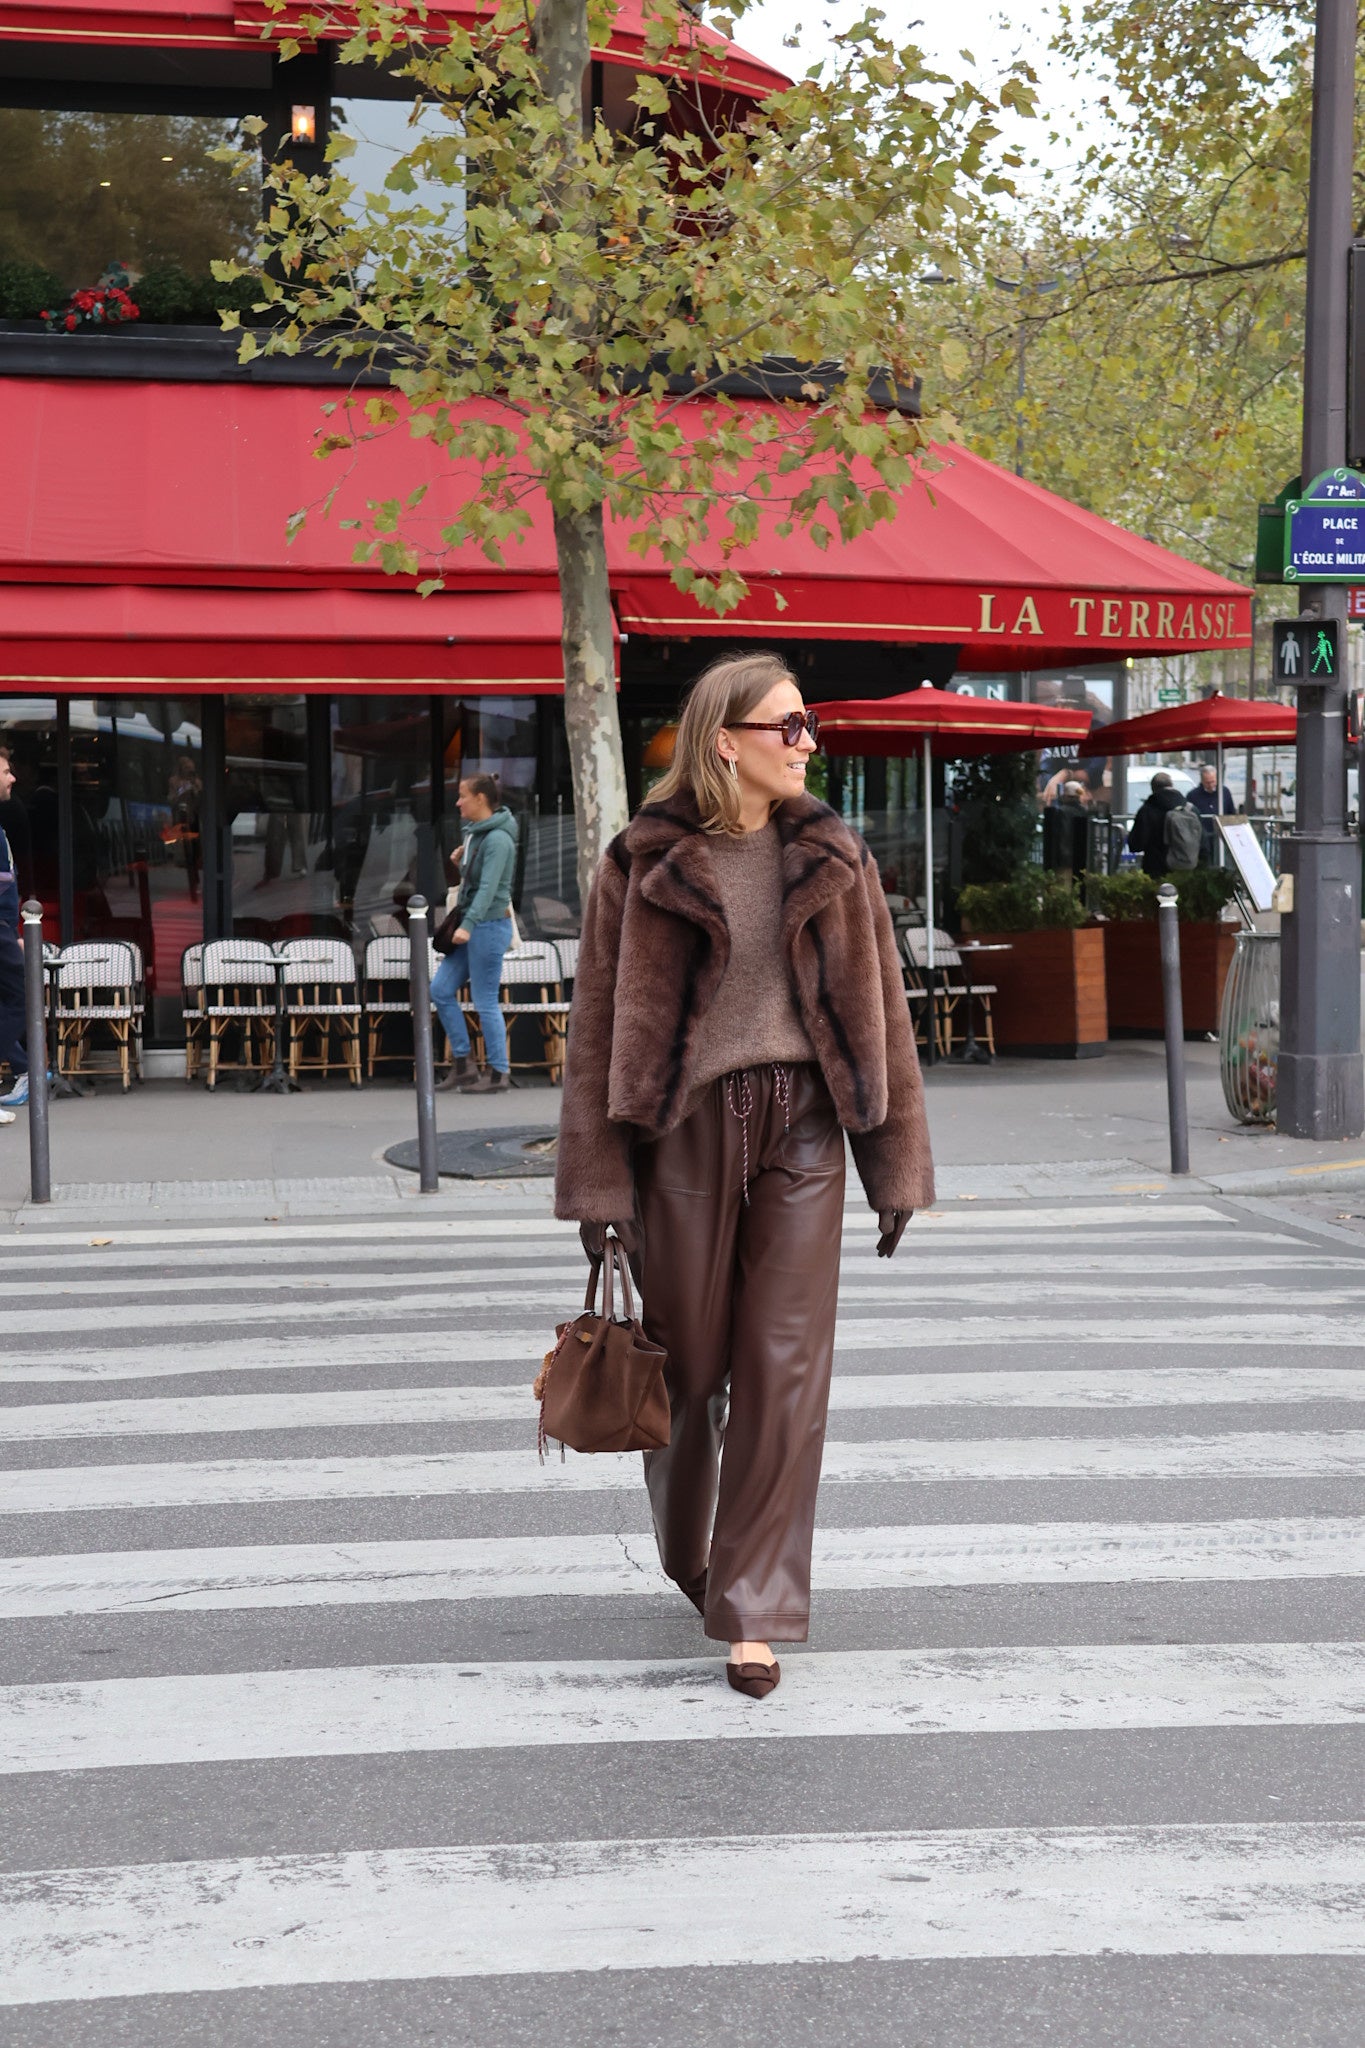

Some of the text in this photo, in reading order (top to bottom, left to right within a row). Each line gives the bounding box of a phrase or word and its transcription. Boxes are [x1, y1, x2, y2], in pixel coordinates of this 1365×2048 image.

[1322, 518, 1358, 530] PLACE
[1335, 537, 1345, 545] DE
[1293, 550, 1334, 565] L'ÉCOLE
[978, 594, 1236, 640] LA TERRASSE
